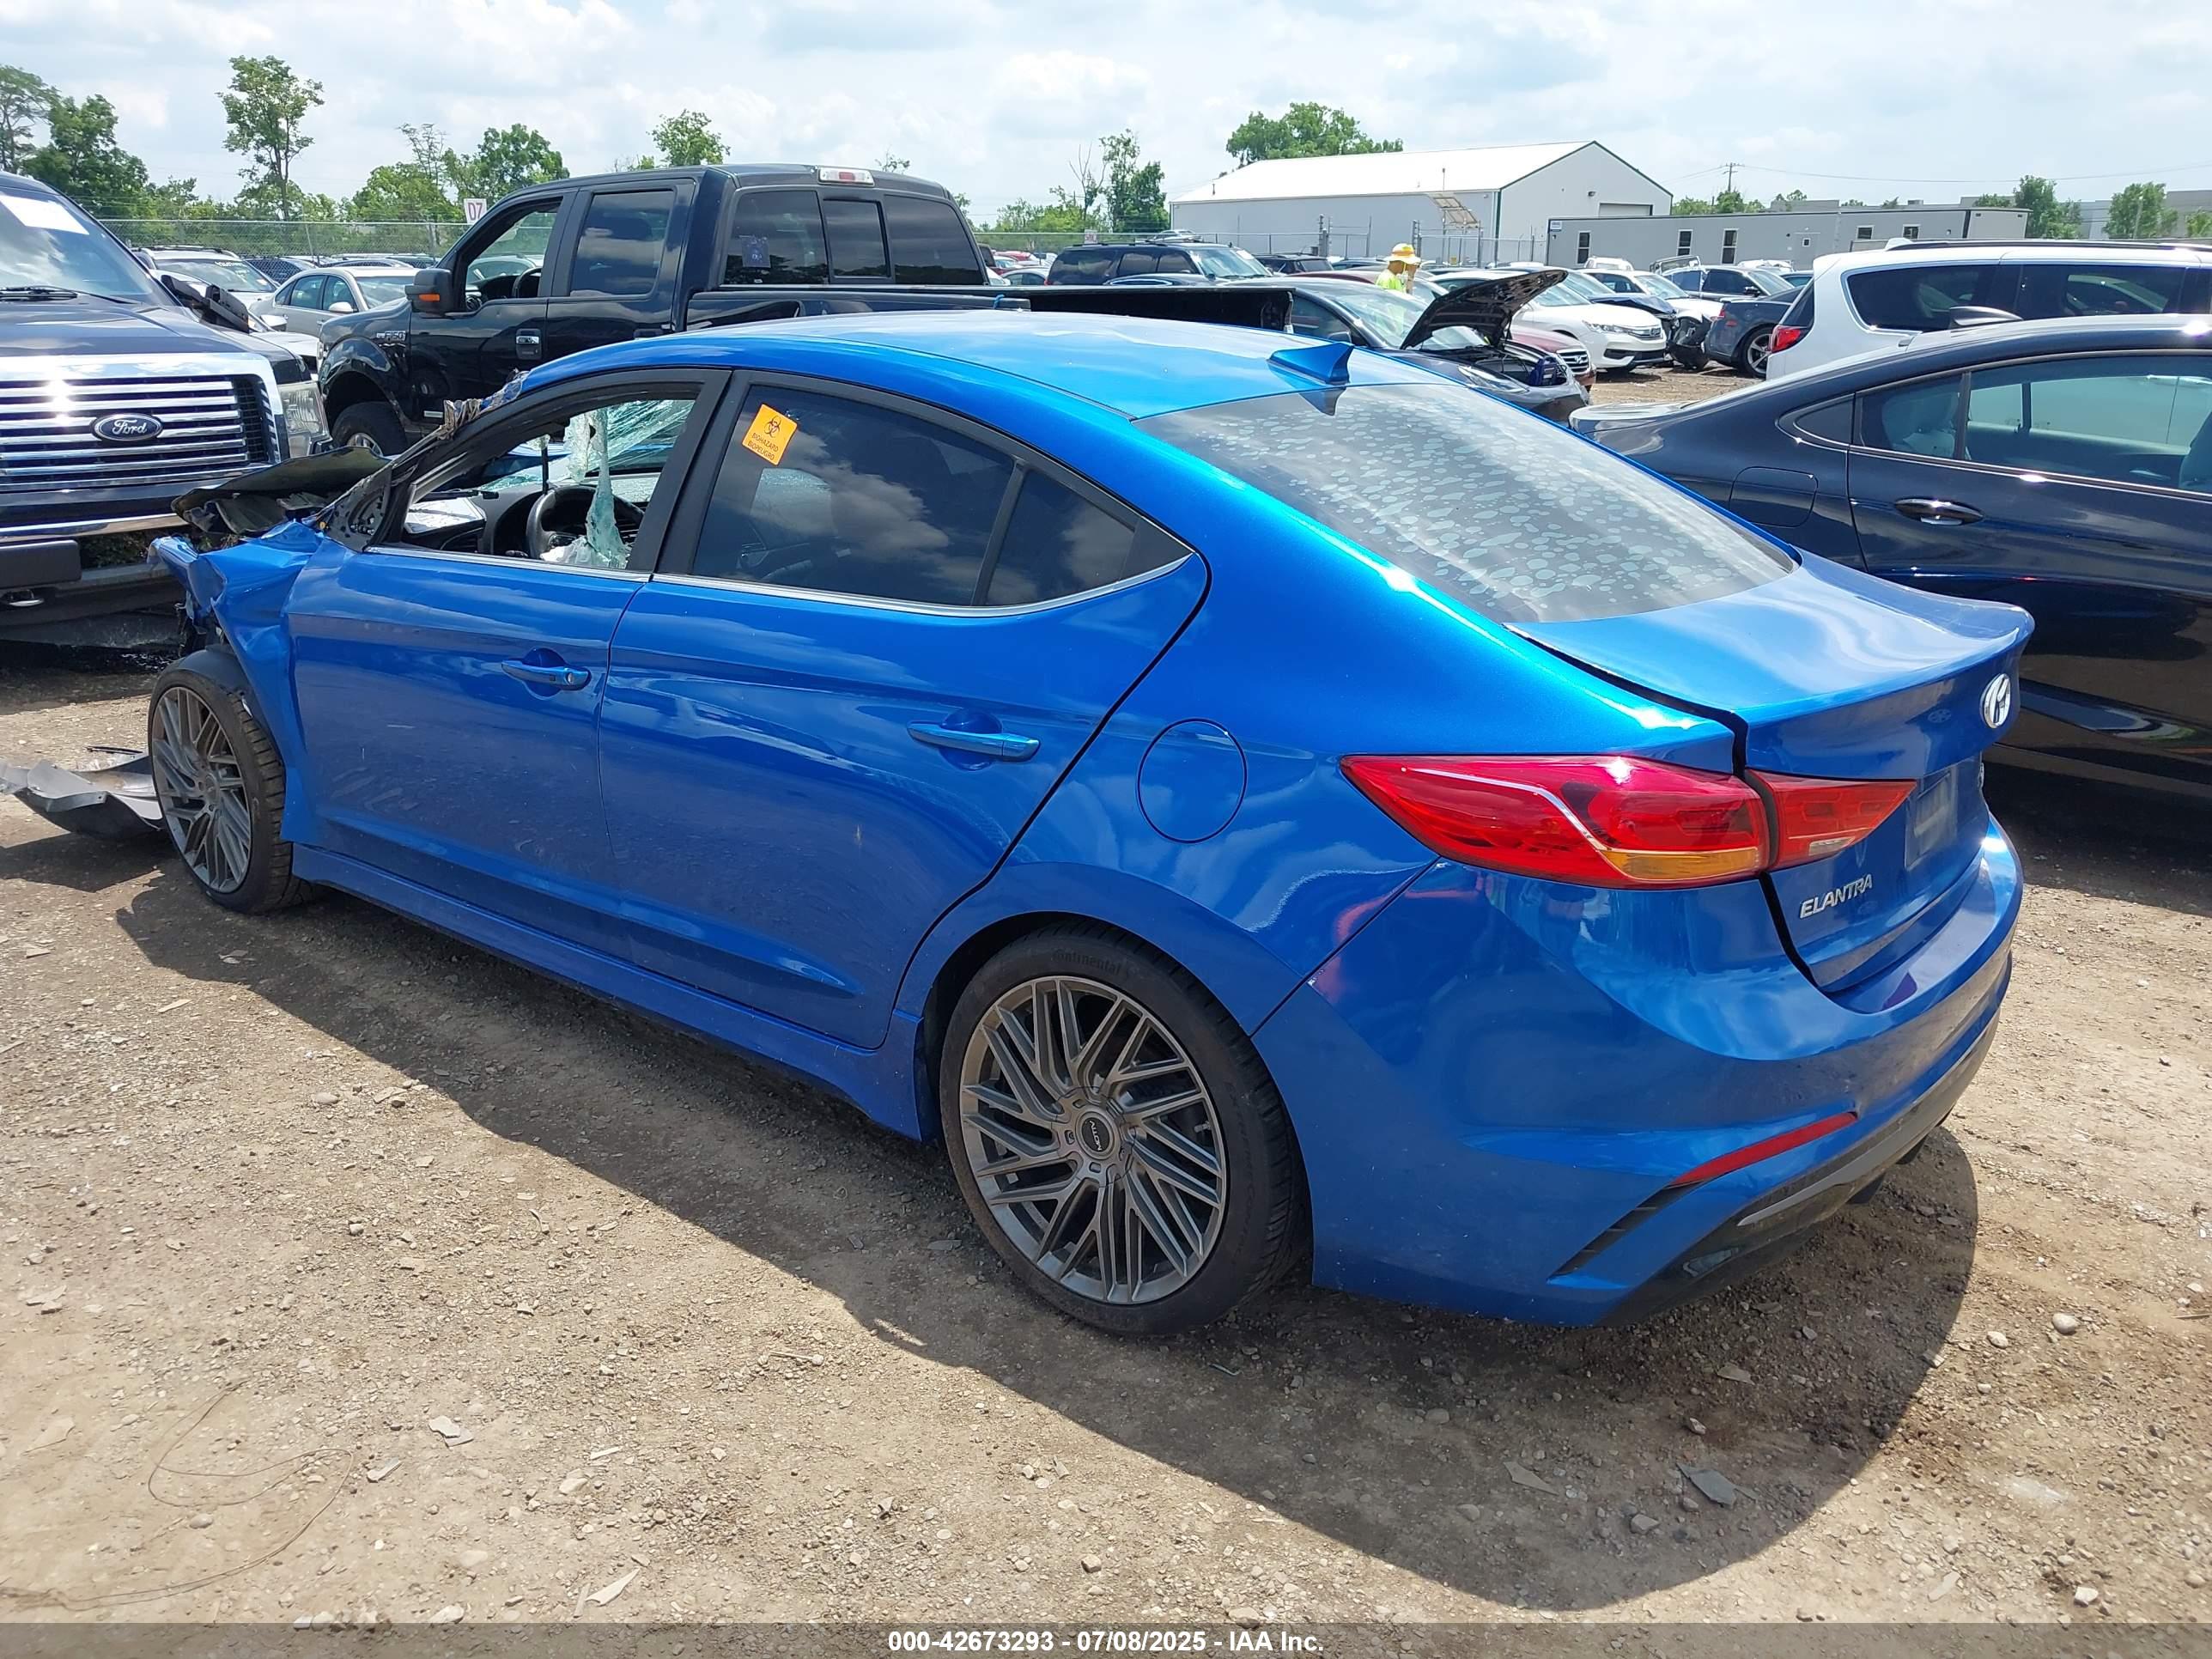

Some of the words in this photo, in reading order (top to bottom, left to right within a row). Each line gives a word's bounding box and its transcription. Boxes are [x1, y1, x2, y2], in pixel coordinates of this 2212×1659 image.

[112, 419, 147, 434] Ford
[747, 440, 775, 460] BIOPELIGRO
[751, 432, 779, 453] BIOHAZARD
[1799, 873, 1872, 919] ELANTRA
[1051, 948, 1121, 975] Continental
